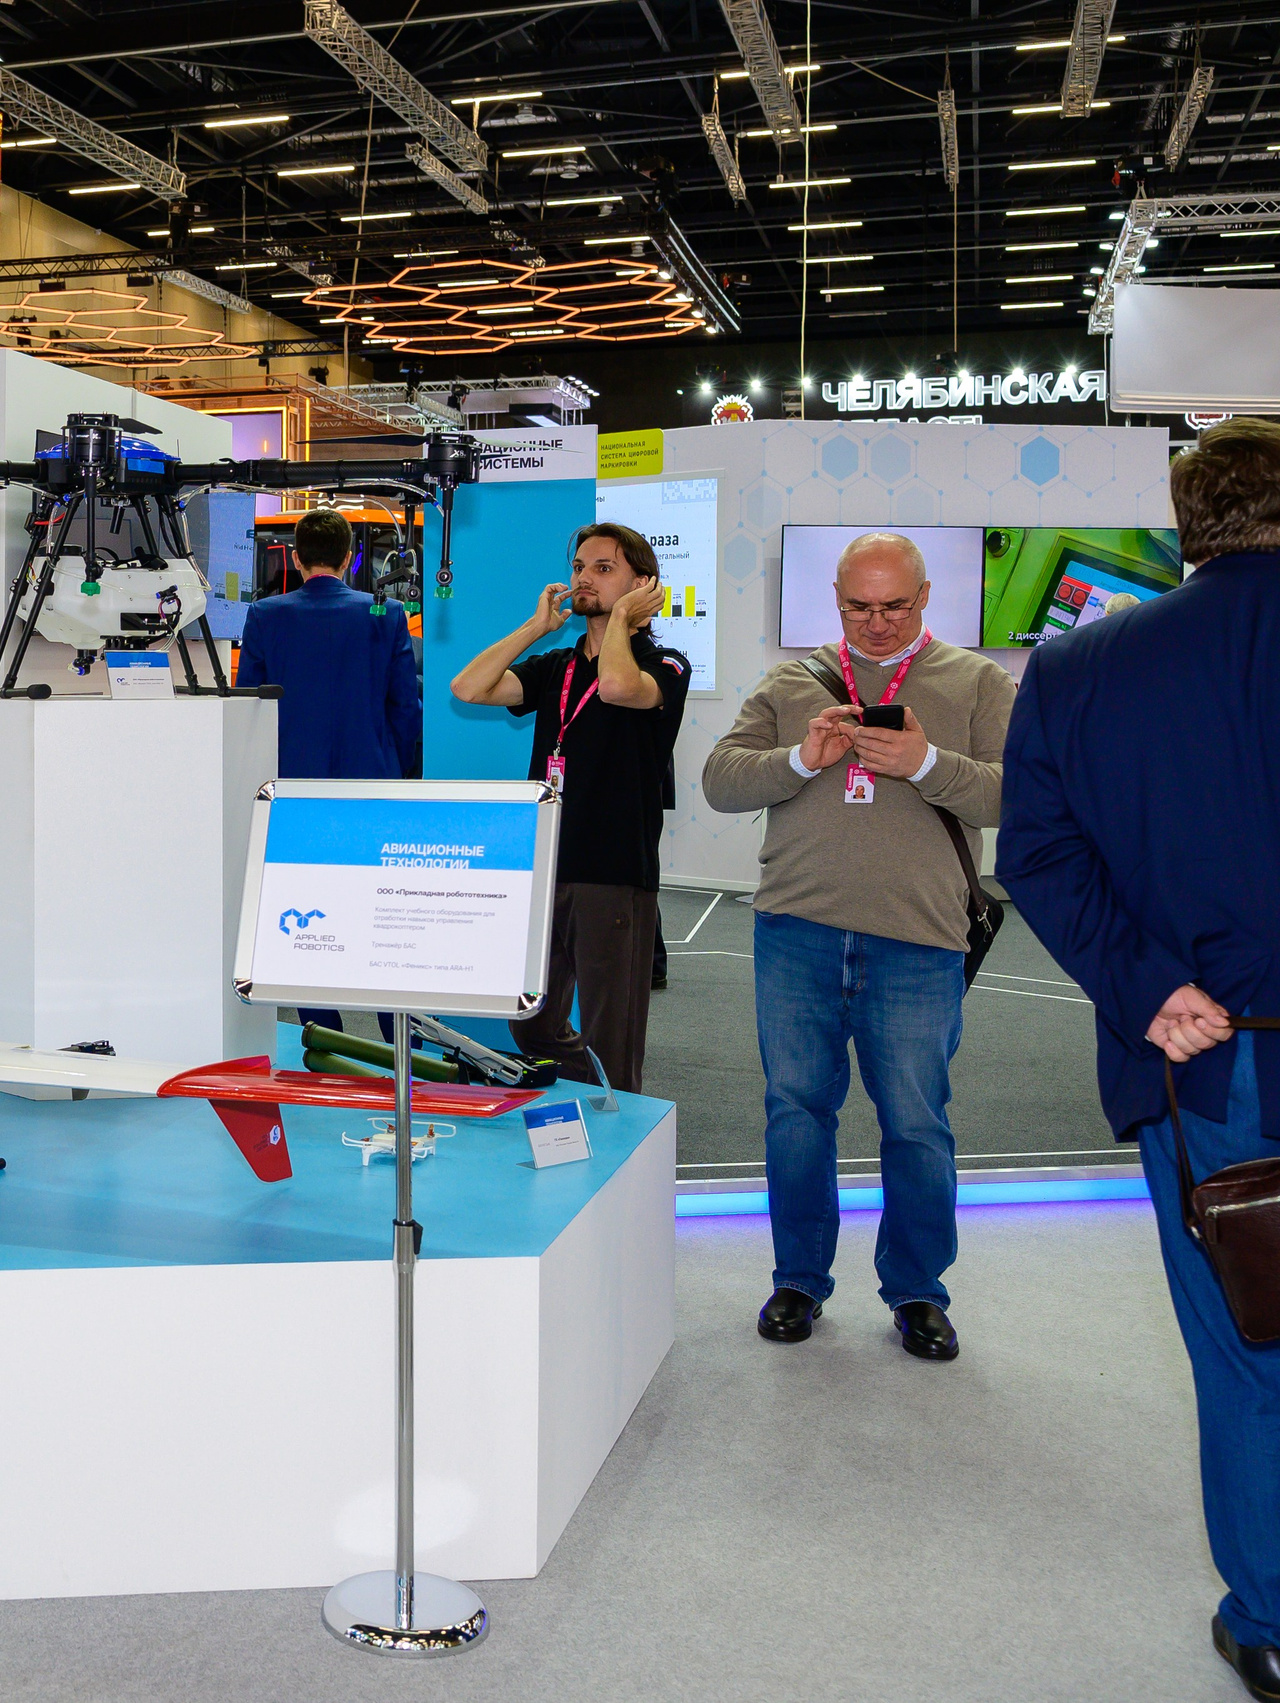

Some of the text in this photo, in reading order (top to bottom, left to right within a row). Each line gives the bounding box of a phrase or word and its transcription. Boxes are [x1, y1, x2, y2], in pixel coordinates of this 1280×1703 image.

[822, 370, 1106, 412] ЧЕЛЯБИНСКАЯ
[601, 441, 645, 450] НАЦИОНАЛЬНАЯ
[629, 448, 658, 458] ЦИФРОВОЙ
[650, 534, 679, 546] раза
[657, 551, 690, 560] егальный
[1008, 632, 1014, 640] 2
[381, 843, 485, 856] АВИАЦИОННЫЕ
[380, 857, 469, 869] ТЕХНОЛОГИИ
[395, 889, 445, 897] «Прикладная
[446, 890, 507, 898] робототехника»
[295, 934, 335, 942] APPLIED
[294, 943, 344, 951] ROBOTICS
